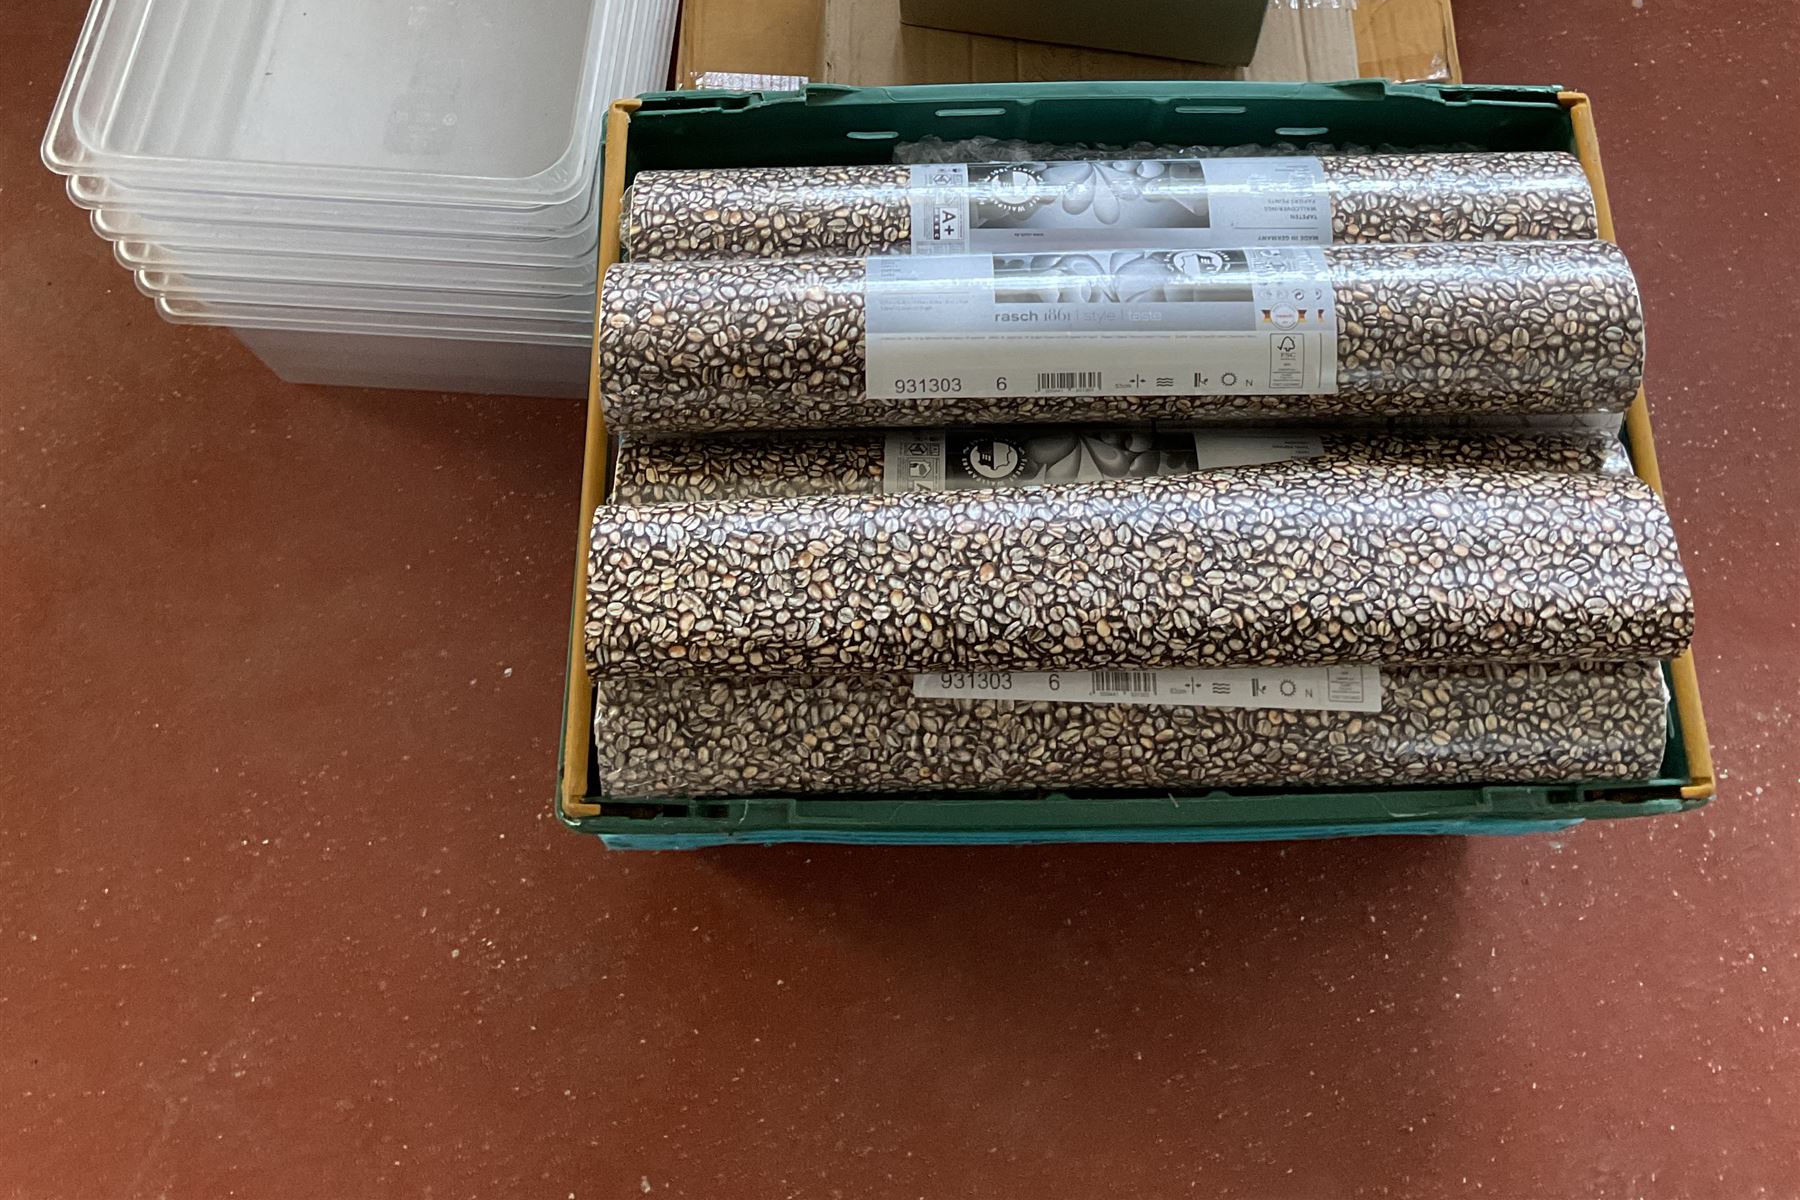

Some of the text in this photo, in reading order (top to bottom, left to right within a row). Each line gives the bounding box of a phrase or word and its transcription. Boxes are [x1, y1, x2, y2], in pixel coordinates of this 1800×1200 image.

[995, 310, 1039, 322] rasch
[1084, 309, 1117, 324] style
[894, 376, 1008, 394] 931303 6
[941, 672, 1060, 691] 931303 6
[1305, 688, 1313, 698] N
